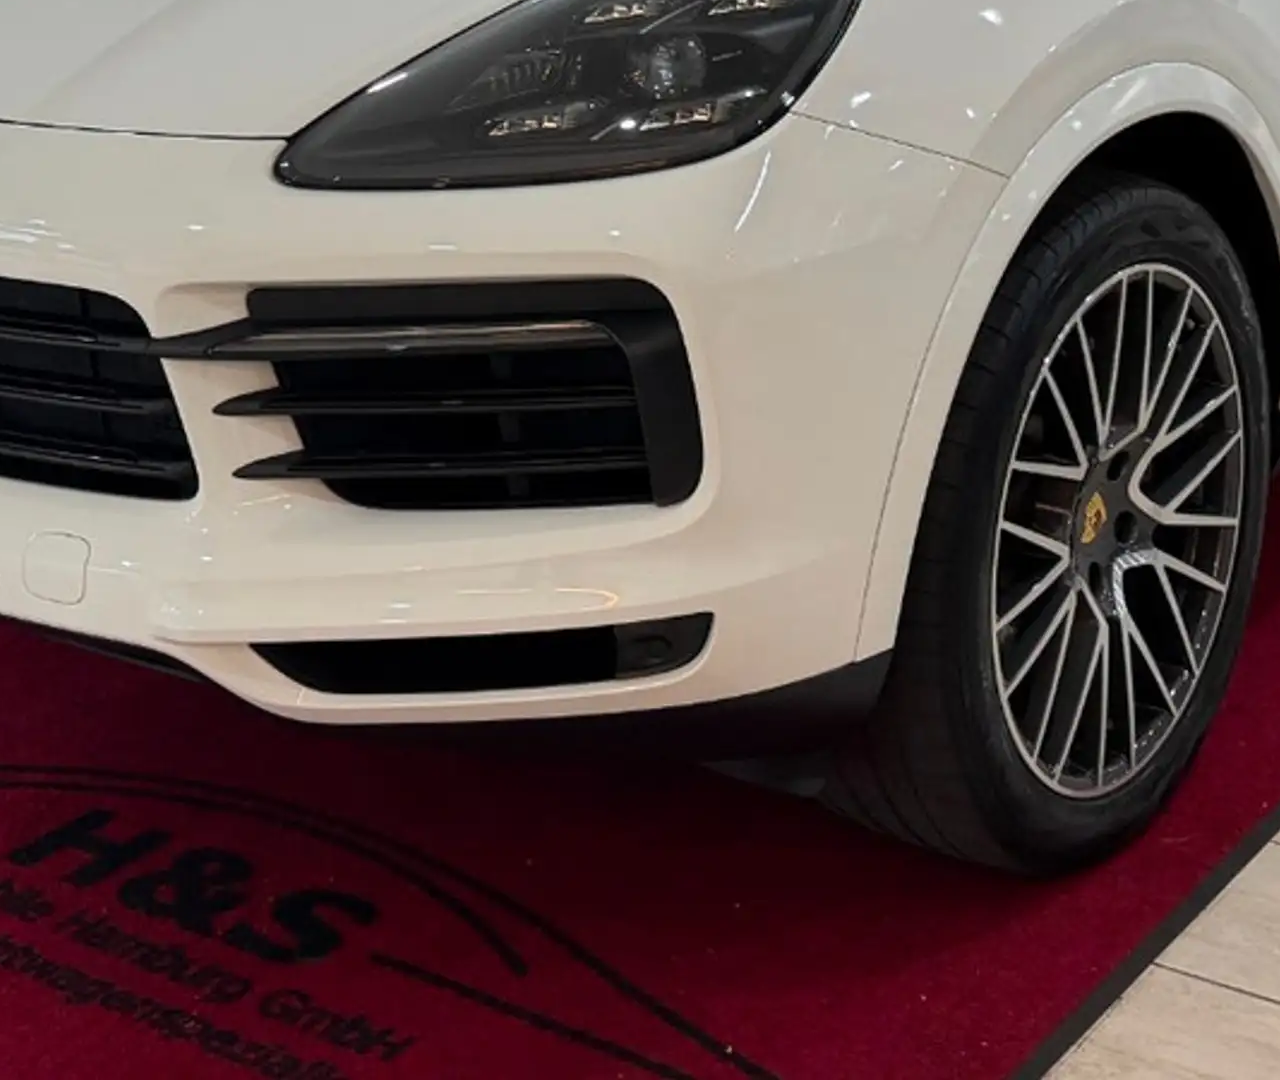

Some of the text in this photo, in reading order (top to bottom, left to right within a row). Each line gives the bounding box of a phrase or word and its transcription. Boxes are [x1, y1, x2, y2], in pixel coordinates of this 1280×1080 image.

[7, 808, 380, 963] H&S
[53, 910, 251, 1004] Hamburg
[259, 988, 418, 1061] GmbH
